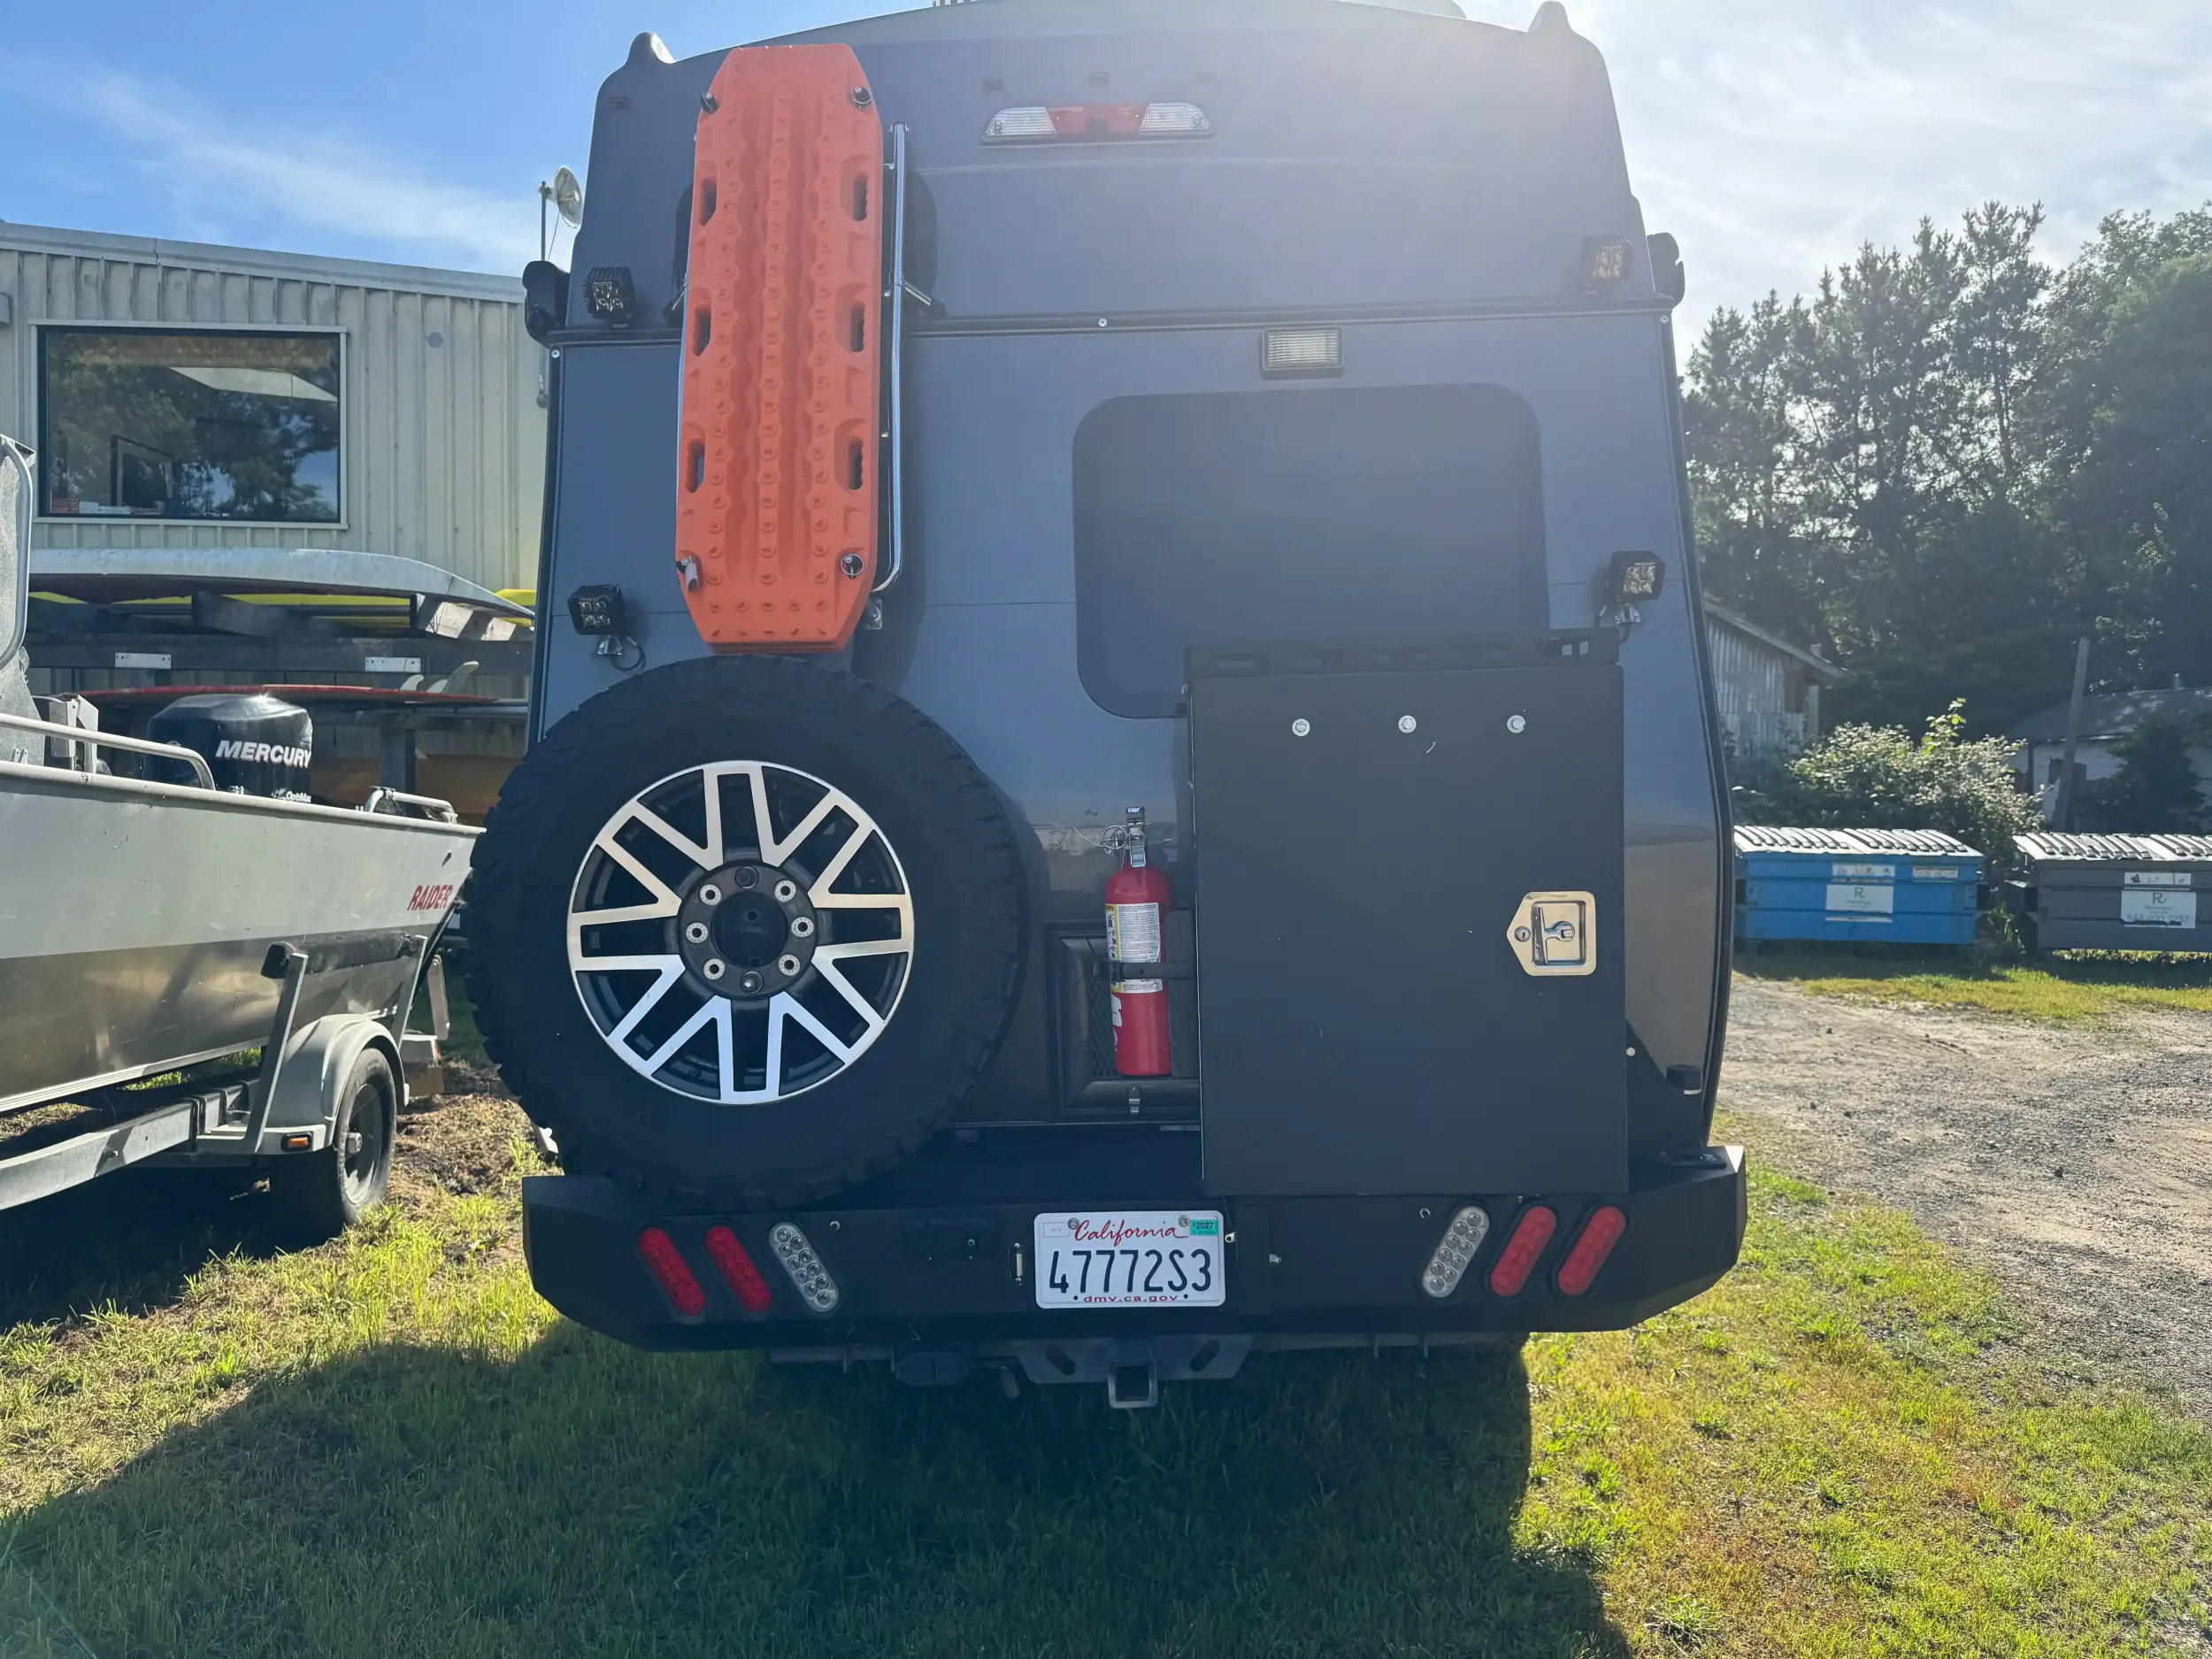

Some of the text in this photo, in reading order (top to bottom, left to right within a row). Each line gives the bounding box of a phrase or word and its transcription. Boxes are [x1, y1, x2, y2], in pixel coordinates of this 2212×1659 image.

[215, 740, 311, 769] MERCURY
[407, 885, 454, 911] RAIDER
[1074, 1219, 1189, 1248] California
[1195, 1221, 1214, 1230] 2027
[1048, 1248, 1212, 1294] 47772S3
[1083, 1294, 1179, 1303] dmv.ca.gov
